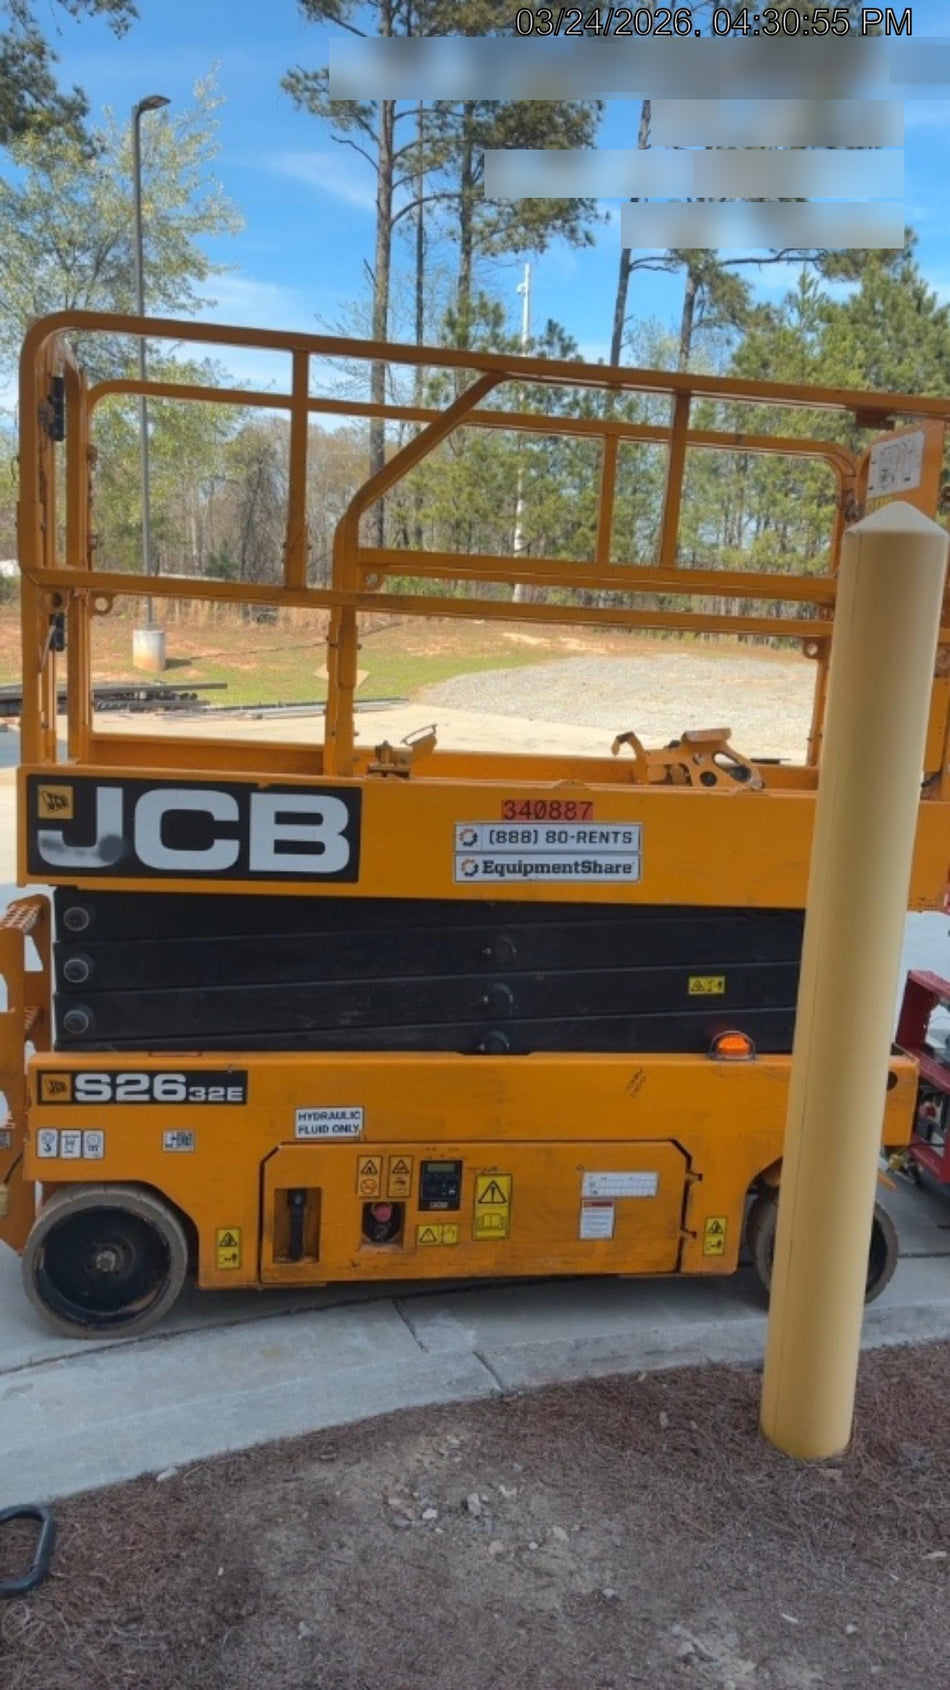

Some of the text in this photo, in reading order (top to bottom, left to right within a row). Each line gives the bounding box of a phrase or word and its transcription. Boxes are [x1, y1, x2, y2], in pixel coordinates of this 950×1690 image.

[503, 800, 593, 821] 340887
[37, 786, 350, 873] JCB
[489, 829, 632, 844] (888) 80-RENTS
[482, 860, 632, 877] EquipmentShare
[298, 1111, 360, 1121] HYDRAULIC
[298, 1123, 359, 1135] FLUID ONLY
